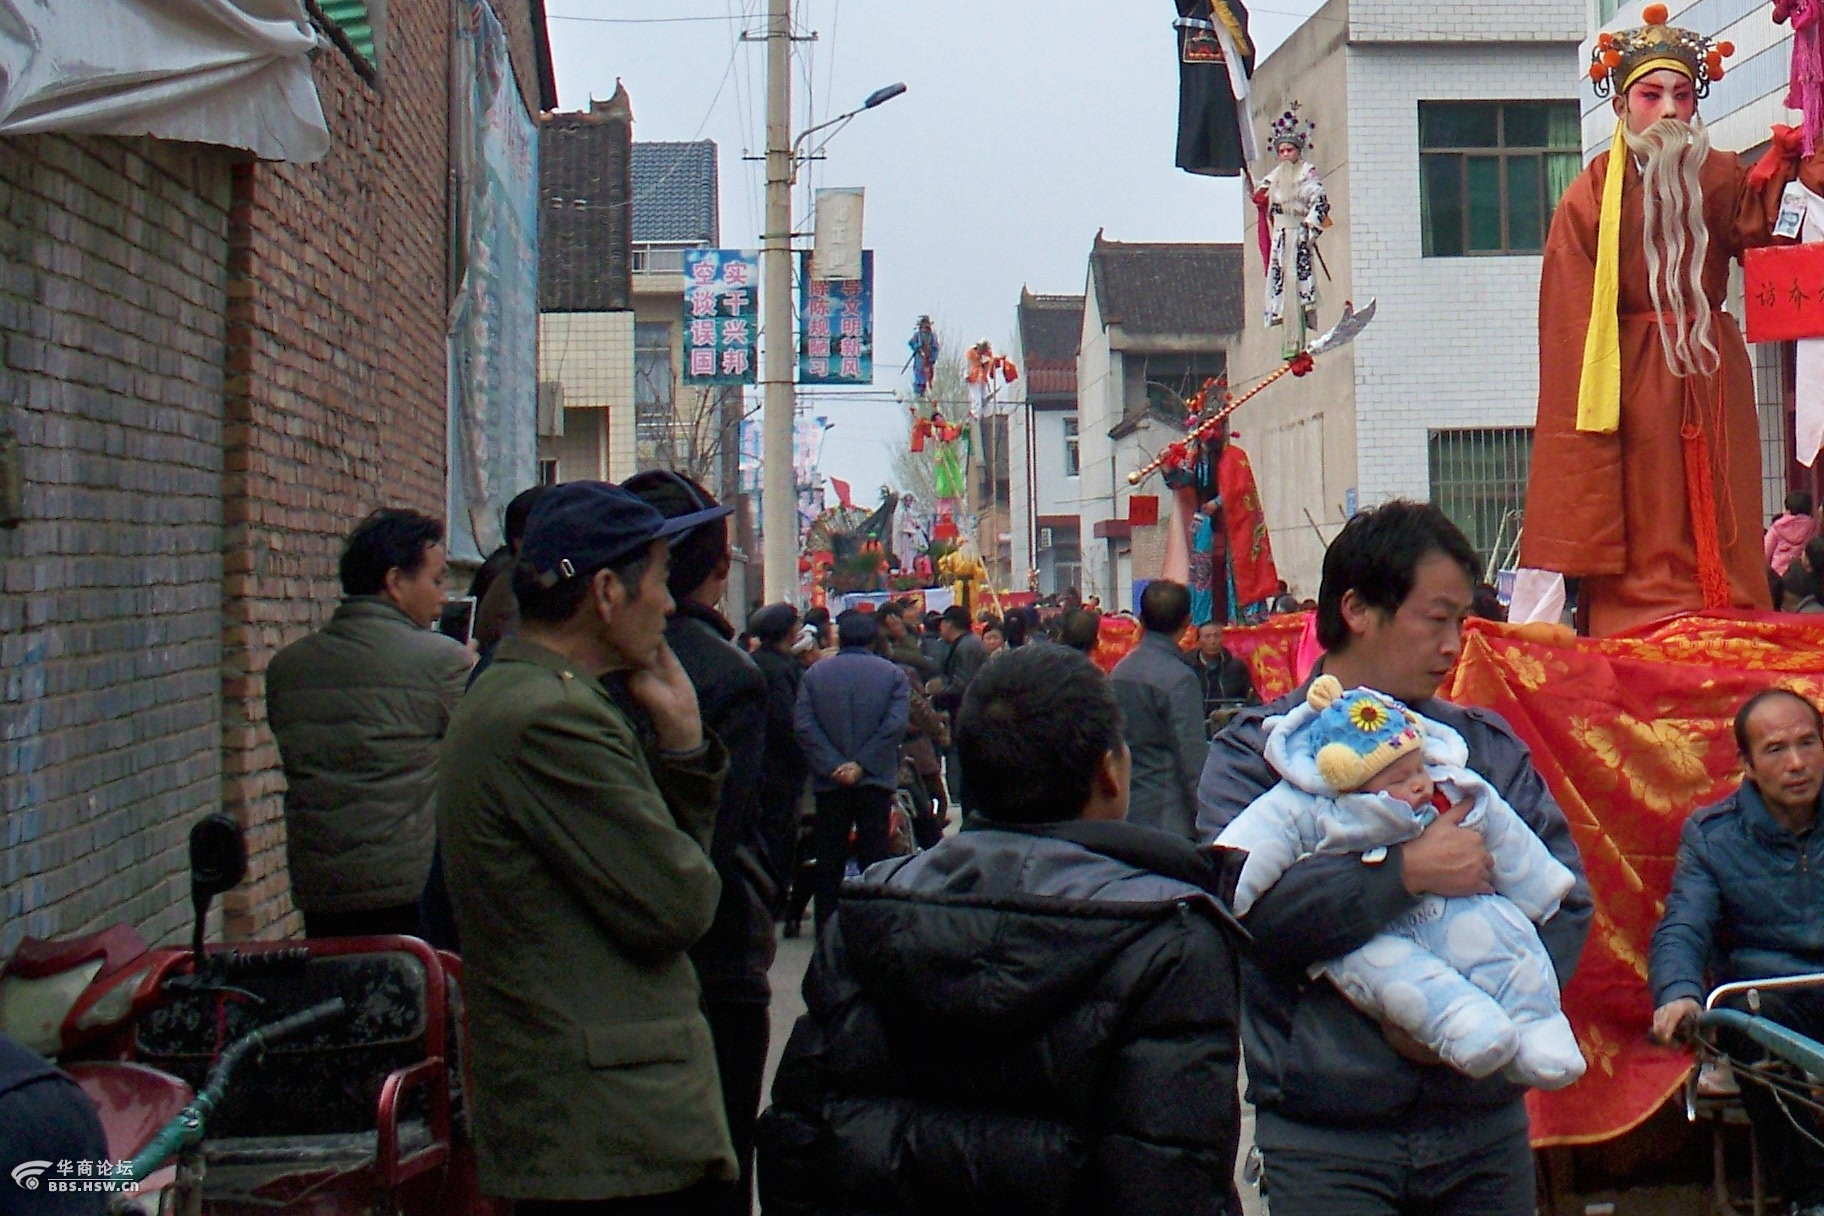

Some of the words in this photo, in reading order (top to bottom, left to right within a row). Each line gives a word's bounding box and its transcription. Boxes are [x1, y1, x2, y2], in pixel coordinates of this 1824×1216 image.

[691, 260, 718, 376] 空谈误国
[722, 259, 749, 375] 实干兴邦
[807, 278, 831, 377] 除陈规陋习
[840, 278, 863, 377] 导文明新风
